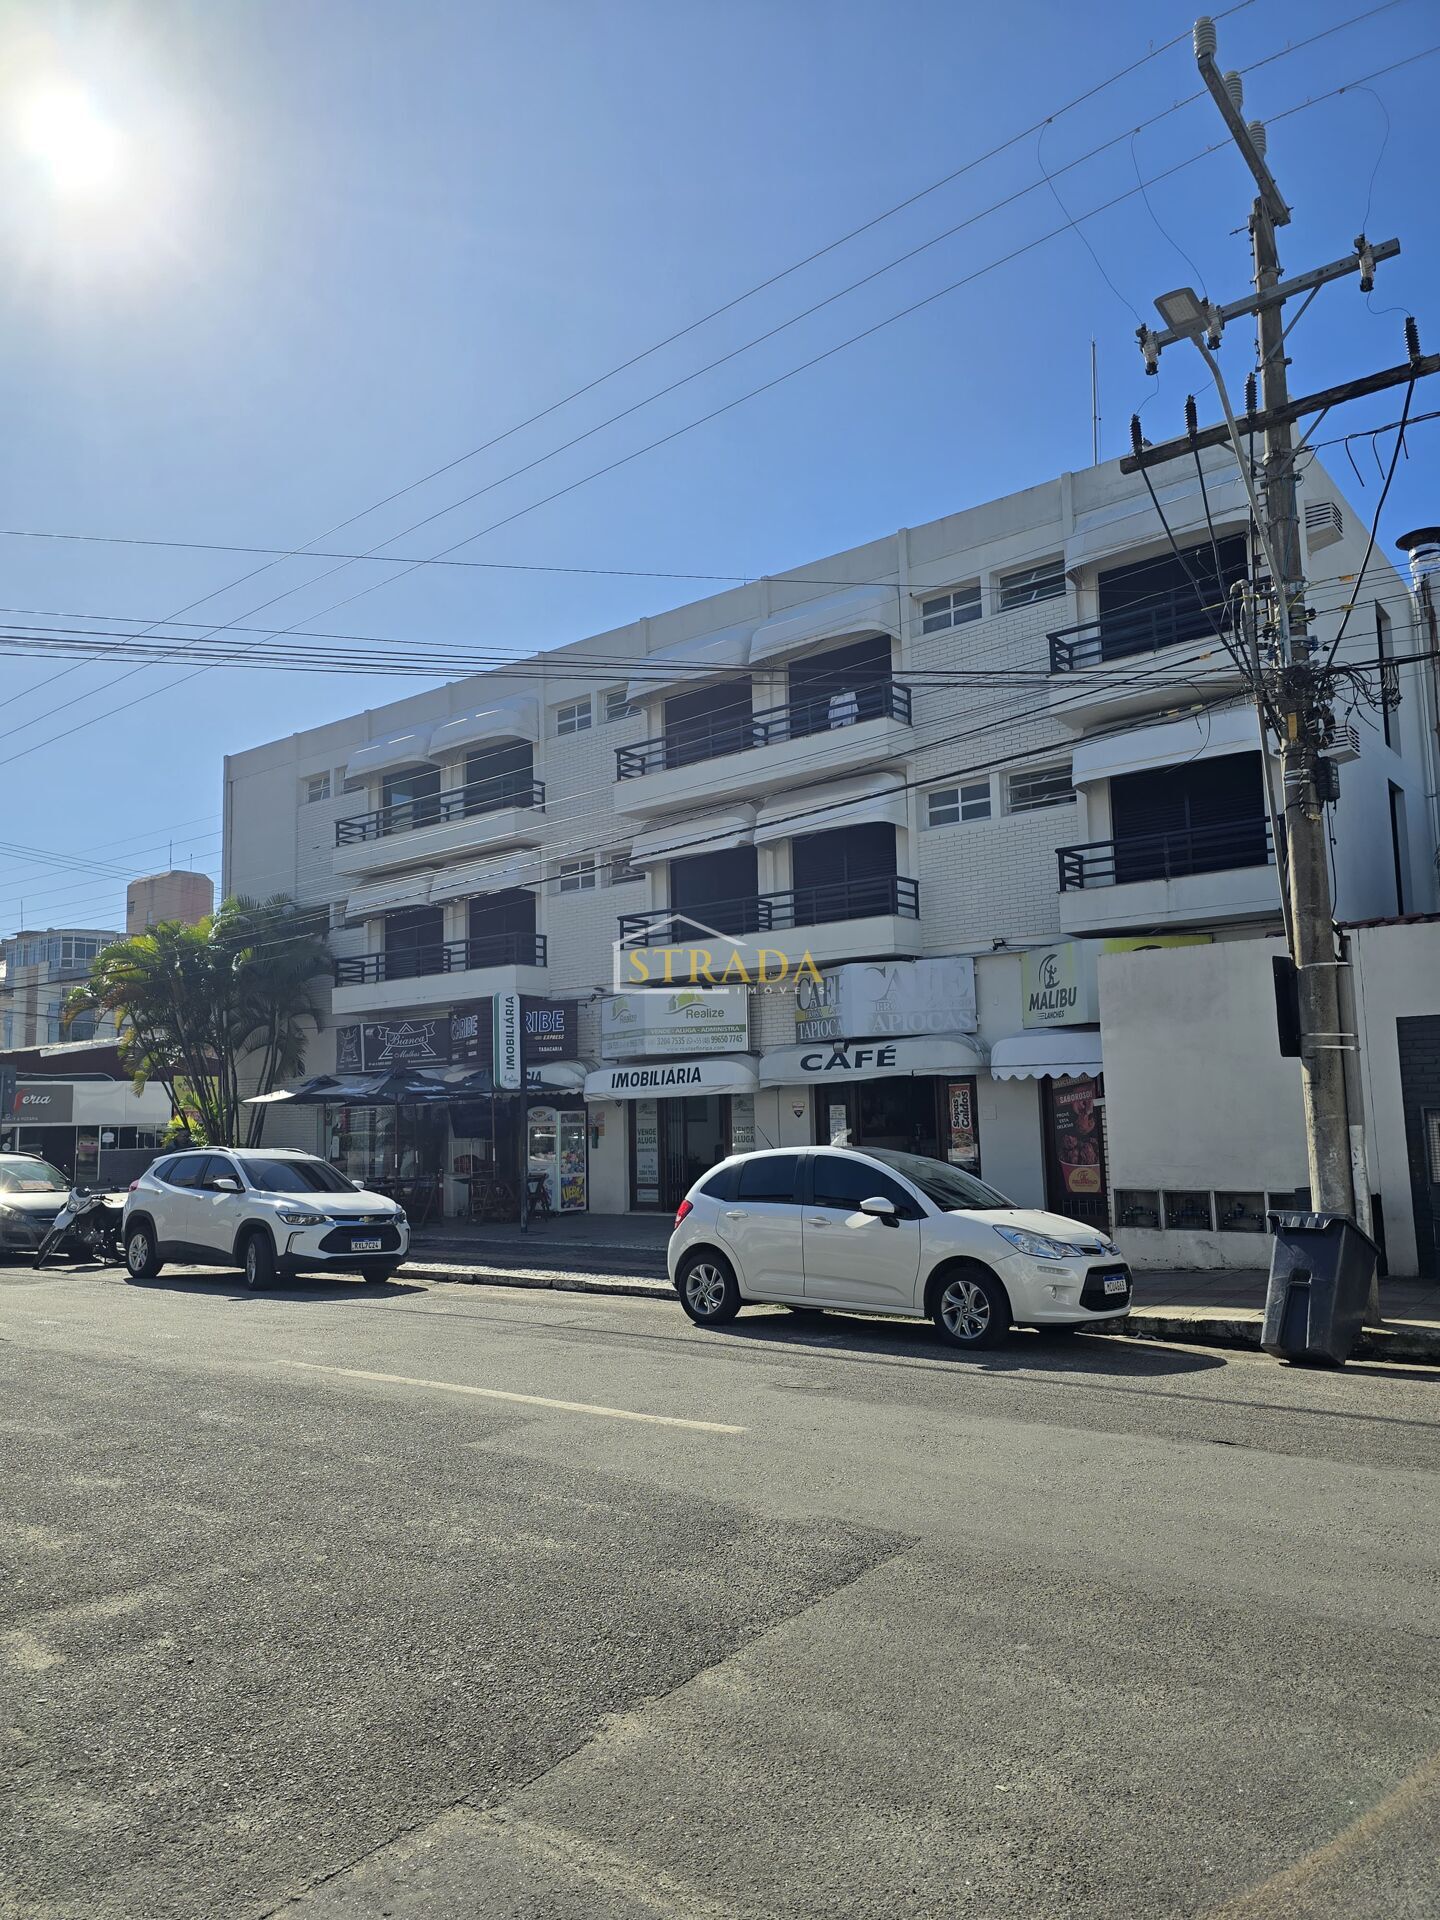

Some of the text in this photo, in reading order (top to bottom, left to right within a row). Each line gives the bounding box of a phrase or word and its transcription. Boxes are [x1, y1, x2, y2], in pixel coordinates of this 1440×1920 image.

[1028, 986, 1078, 1012] MALIBU
[686, 1007, 725, 1020] Realize
[390, 1032, 425, 1046] Bianca
[505, 995, 515, 1070] IMOBILIÁRIA
[701, 1025, 740, 1033] ADMINISTRA
[800, 1045, 897, 1072] CAFÉ
[611, 1066, 702, 1089] IMOBILIÁRIA
[953, 1098, 961, 1128] Sopas
[960, 1090, 970, 1128] Caldos
[637, 1136, 657, 1145] ALUGA
